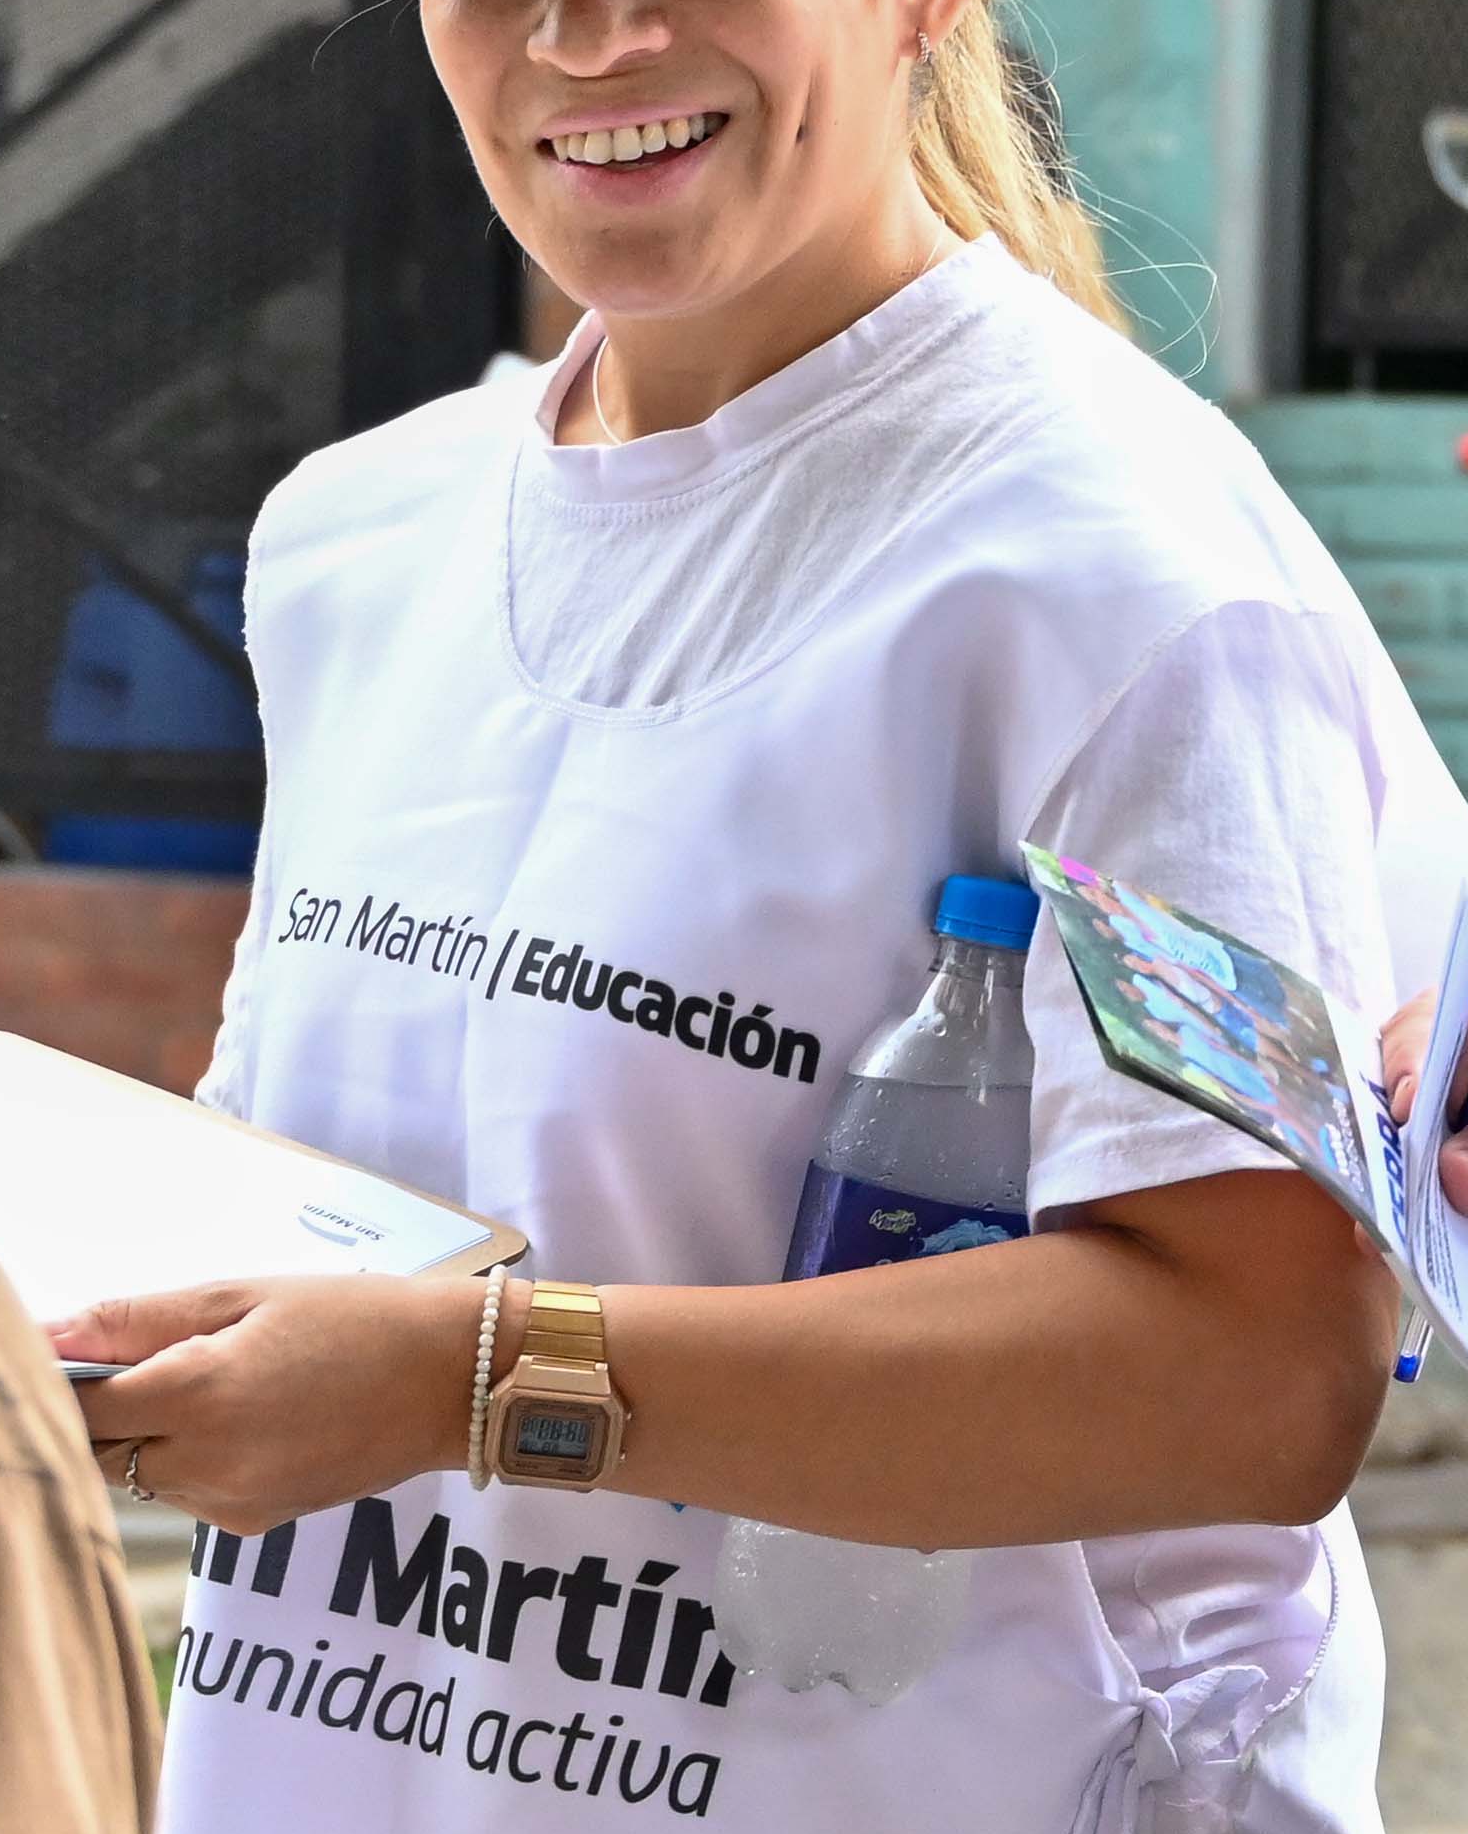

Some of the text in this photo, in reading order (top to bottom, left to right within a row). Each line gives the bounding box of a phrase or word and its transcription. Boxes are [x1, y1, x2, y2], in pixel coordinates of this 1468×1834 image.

[278, 887, 822, 1085] San Martín Educación
[355, 1225, 385, 1241] San
[328, 1497, 737, 1708] Martín
[466, 1709, 722, 1818] activa
